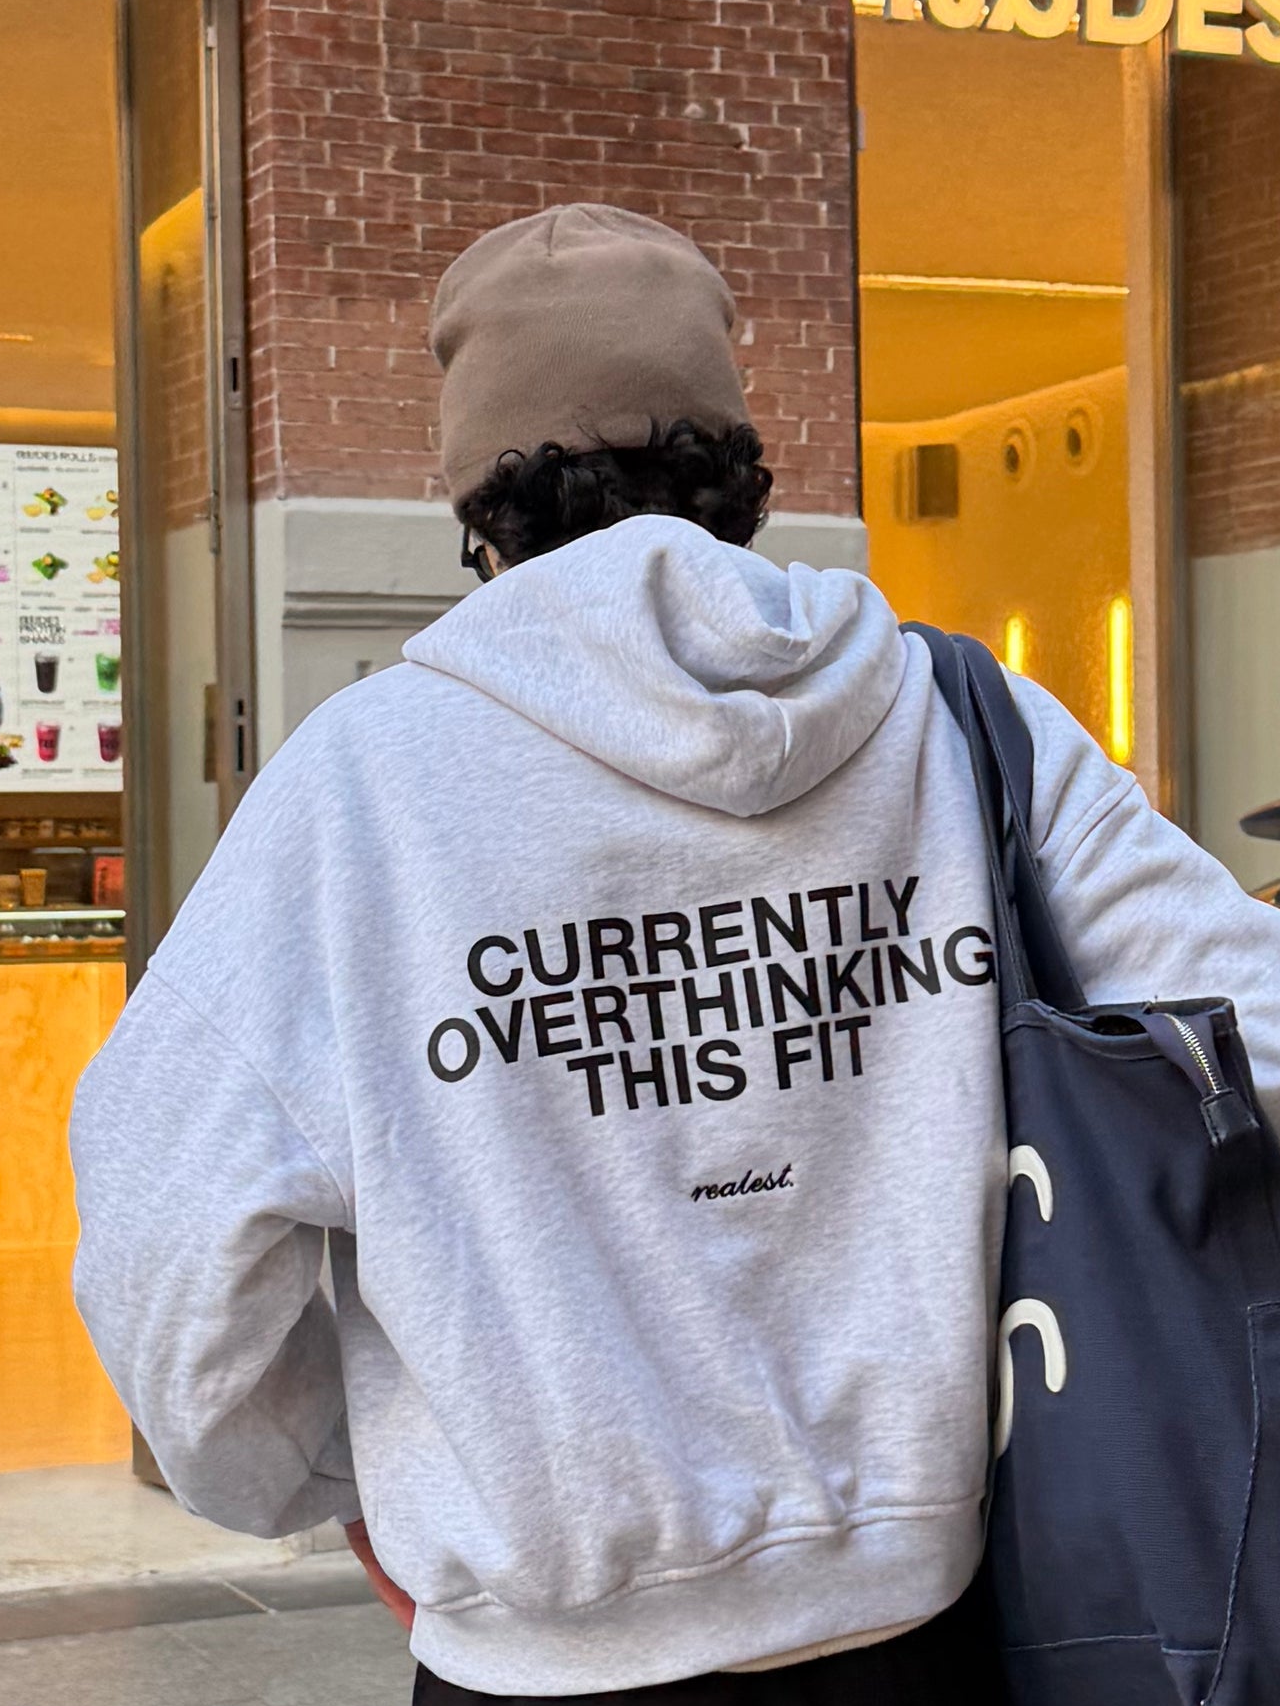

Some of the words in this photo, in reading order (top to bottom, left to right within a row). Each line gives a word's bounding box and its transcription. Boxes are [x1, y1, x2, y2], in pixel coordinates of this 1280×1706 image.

[466, 875, 920, 997] CURRENTLY
[427, 925, 995, 1083] OVERTHINKING
[566, 1039, 748, 1117] THIS
[772, 1015, 872, 1091] FIT
